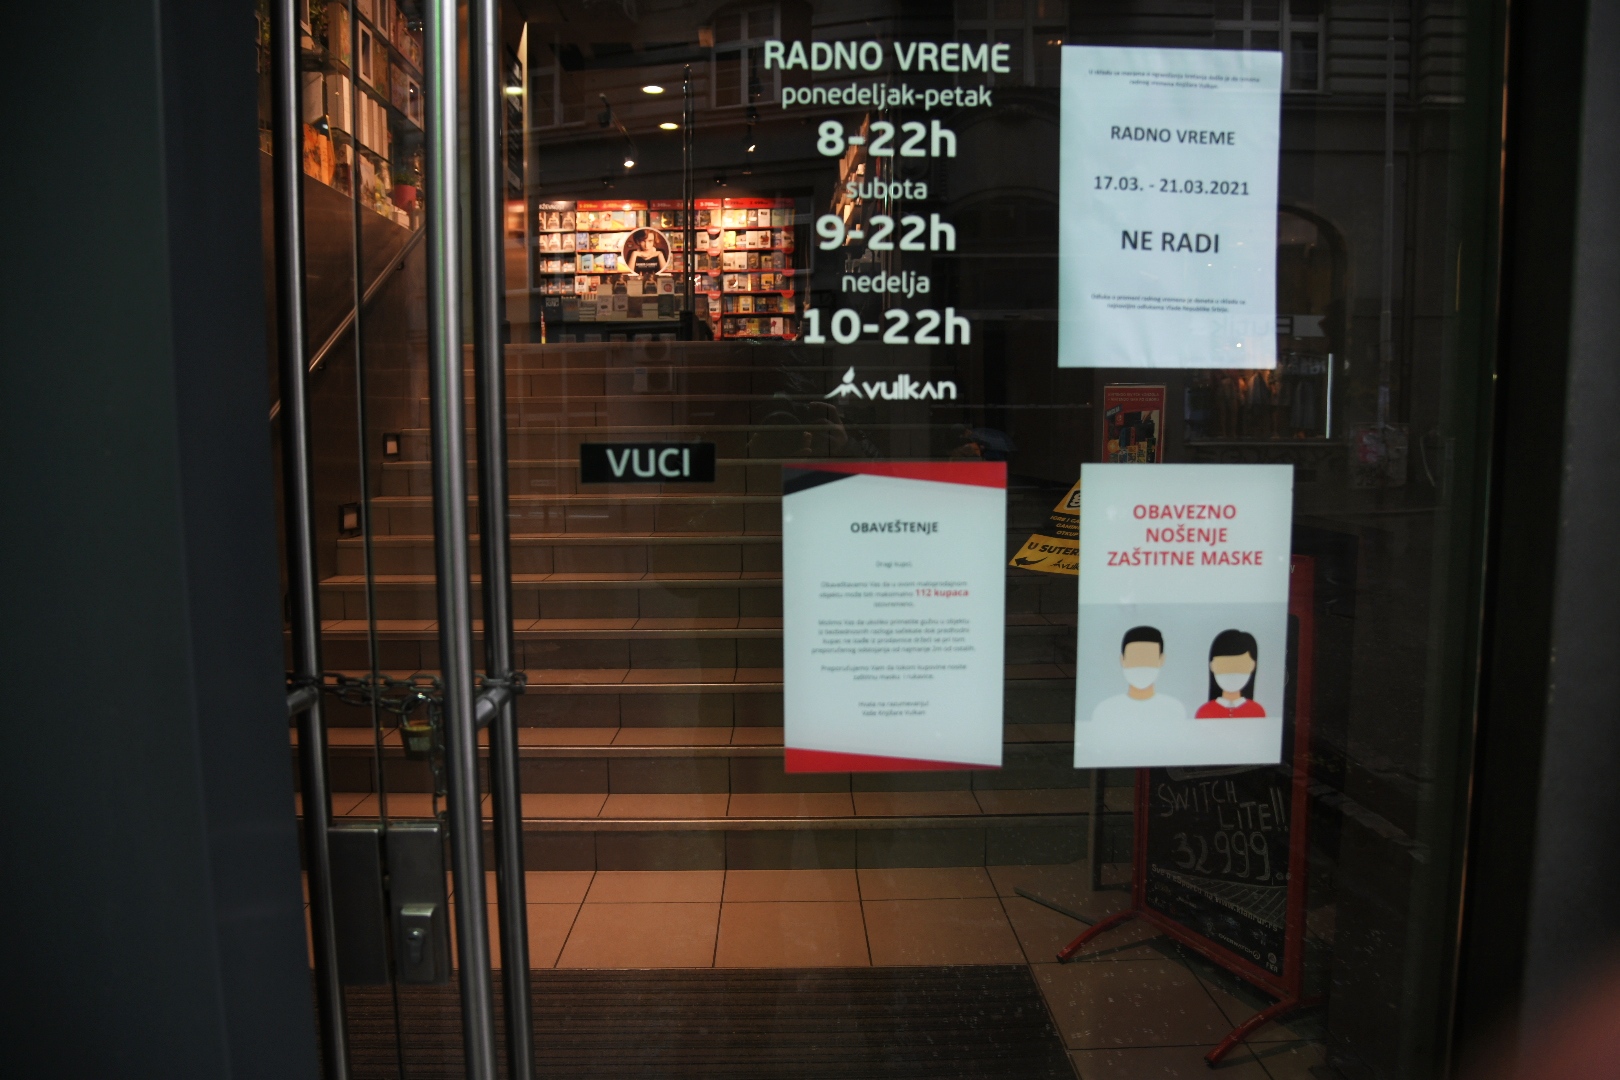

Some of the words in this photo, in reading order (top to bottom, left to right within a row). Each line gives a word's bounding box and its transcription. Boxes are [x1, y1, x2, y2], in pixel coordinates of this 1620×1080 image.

[764, 40, 883, 71] RADNO
[893, 41, 1010, 73] VREME
[782, 83, 992, 111] ponedeljak-petak
[816, 119, 957, 157] 8-22h
[1111, 125, 1171, 144] RADNO
[1175, 129, 1235, 146] VREME
[846, 177, 928, 200] subota
[1093, 176, 1144, 191] 17.03.
[1159, 178, 1249, 196] 21.03.2021
[815, 213, 956, 251] 9-22h
[1120, 230, 1153, 251] NE
[1160, 232, 1219, 254] RADI
[841, 270, 931, 299] nedelja
[803, 307, 971, 345] 10-22h
[862, 373, 957, 401] vulkan
[605, 448, 691, 477] VUCI
[1133, 504, 1236, 520] OBAVEZNO
[850, 519, 938, 535] OBAVEŠTENJE
[1146, 524, 1227, 546] NOŠENJE
[1028, 541, 1039, 550] U
[1039, 544, 1079, 557] SUTER
[1107, 547, 1195, 566] ZAŠTITNE
[1200, 551, 1263, 566] MASKE
[916, 588, 932, 597] 112
[934, 588, 969, 600] kupaca
[1157, 780, 1238, 818] SWITCH
